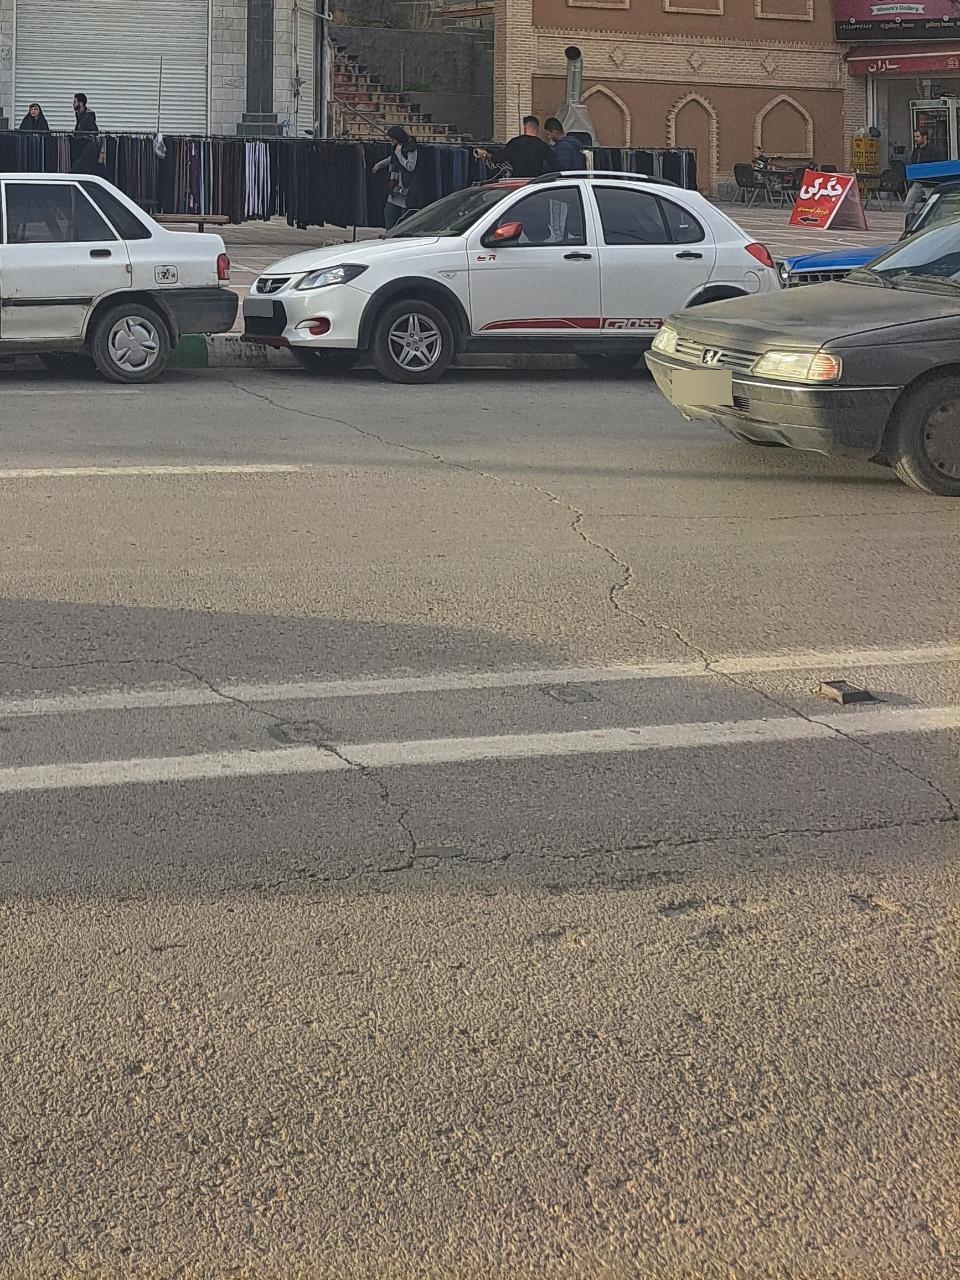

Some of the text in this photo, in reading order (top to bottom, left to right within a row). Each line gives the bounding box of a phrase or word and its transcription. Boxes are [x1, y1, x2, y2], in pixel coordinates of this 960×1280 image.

[868, 59, 900, 72] باران
[799, 176, 843, 202] جگرکی
[604, 318, 661, 330] CROSS
